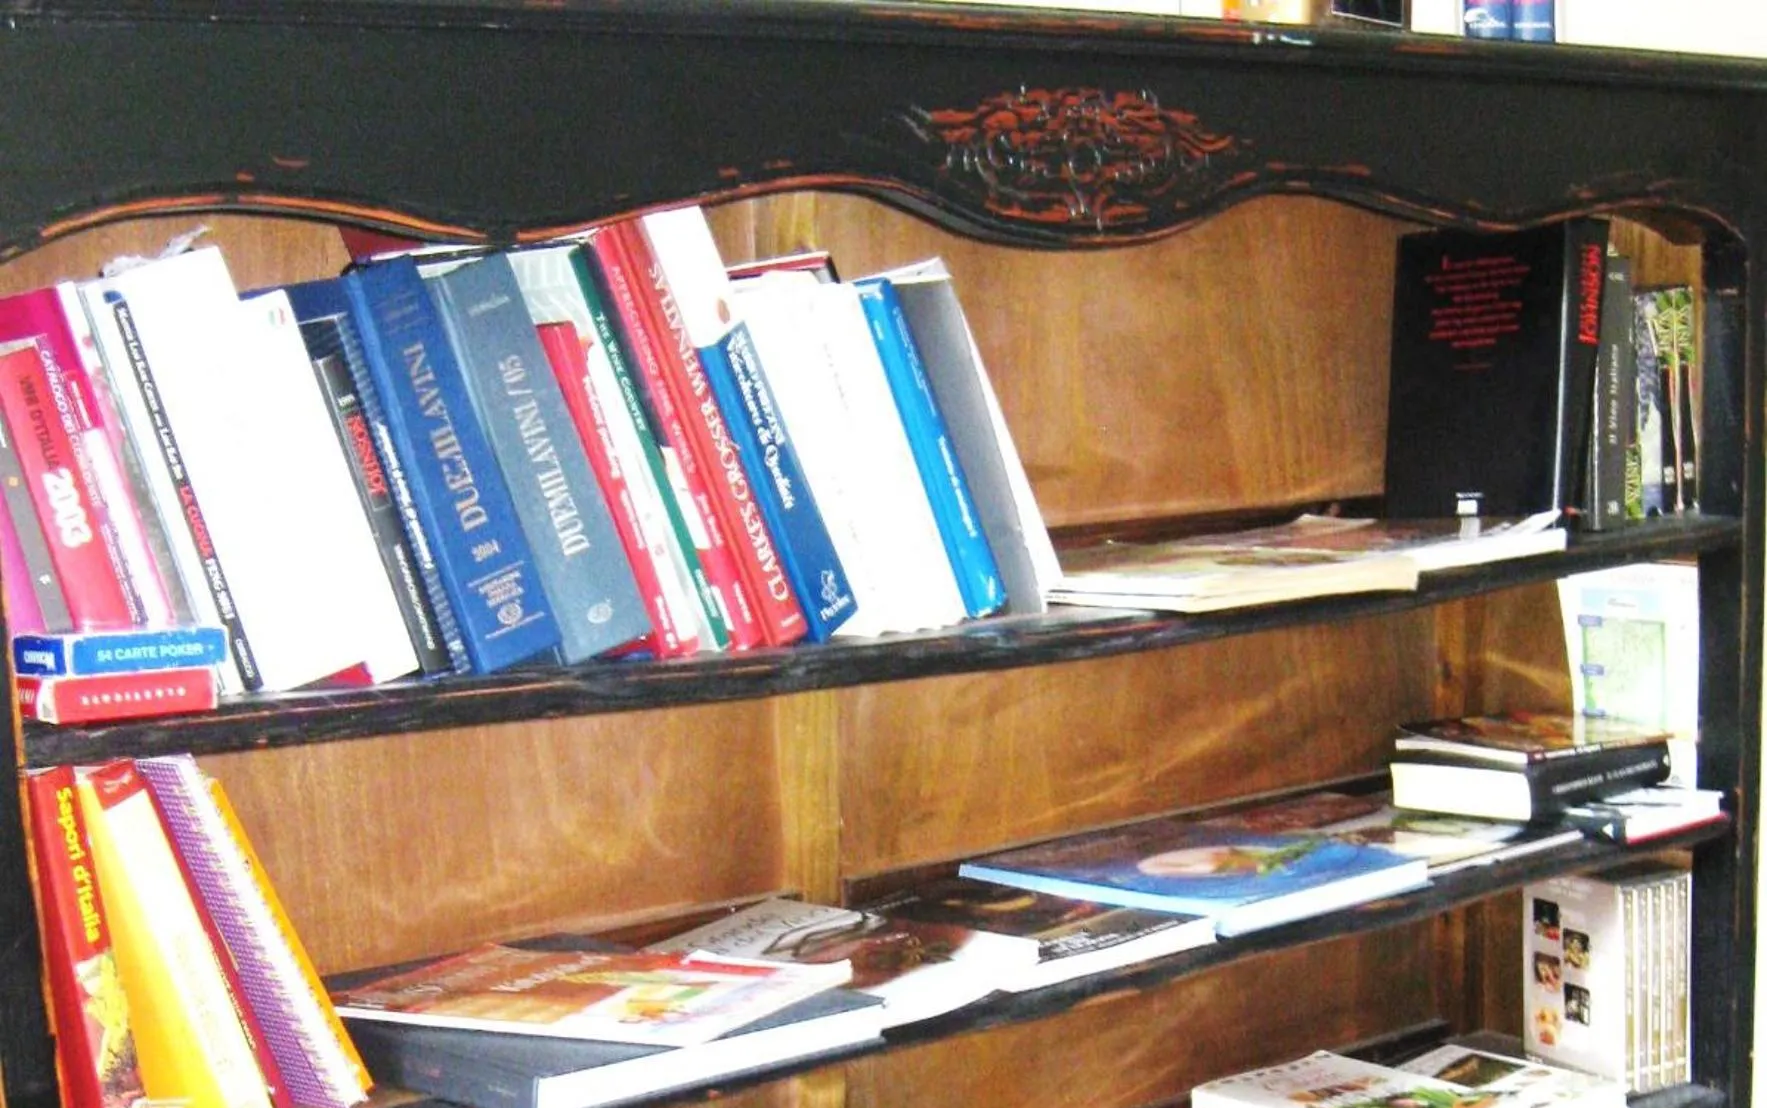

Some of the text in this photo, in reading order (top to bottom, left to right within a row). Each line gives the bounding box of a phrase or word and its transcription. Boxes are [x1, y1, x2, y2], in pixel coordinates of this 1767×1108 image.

[40, 464, 95, 551] 2003
[511, 398, 592, 557] DUEMILAVINI
[97, 643, 204, 662] 54 CARTE POKER
[53, 786, 103, 943] Sapori d'Italia
